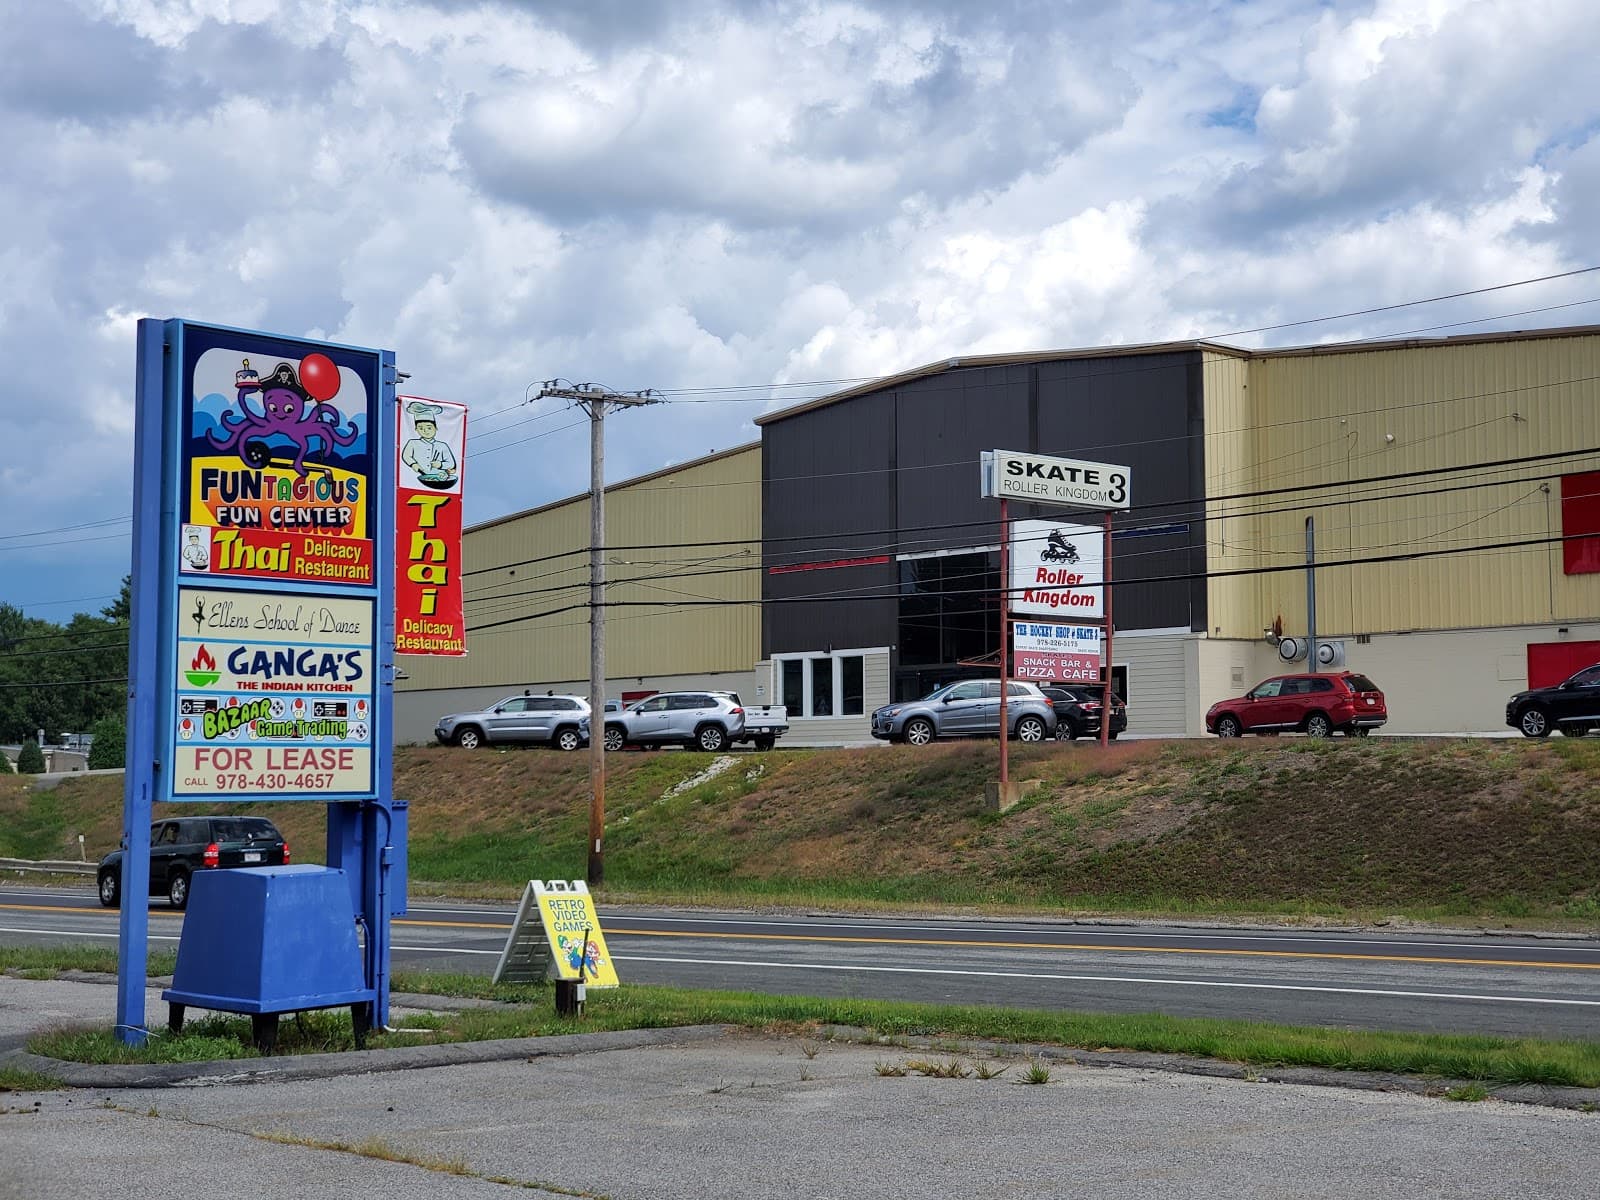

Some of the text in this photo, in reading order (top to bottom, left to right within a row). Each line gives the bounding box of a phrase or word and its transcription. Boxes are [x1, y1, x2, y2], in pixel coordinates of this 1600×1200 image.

[201, 468, 360, 504] FUNTAGIOUS
[1004, 479, 1107, 502] ROLLER KINGDOM
[1006, 460, 1126, 503] SKATE 3
[216, 506, 352, 527] FUN CENTER
[213, 530, 291, 572] Thai
[304, 538, 361, 563] Delicacy
[295, 557, 370, 580] Restaurant
[1035, 567, 1084, 585] Roller
[1023, 588, 1095, 608] Kingdom
[208, 600, 361, 638] Ellens School of Dance
[403, 618, 454, 638] Delicacy
[396, 634, 462, 651] Restaurant
[1056, 626, 1071, 639] SHOP
[227, 646, 363, 682] GANGA'S
[1023, 657, 1092, 668] SNACK BAR &
[1017, 666, 1097, 680] PIZZA CAFE
[236, 681, 353, 692] THE INDIAN KITCHEN
[203, 698, 273, 740] BAZAAR
[256, 720, 348, 739] Game Trading
[195, 748, 354, 771] FOR LEASE
[184, 774, 335, 790] CALL 978-430-4657
[549, 899, 585, 910] RETRO
[552, 910, 587, 921] VIDEO
[553, 921, 594, 932] GAMES
